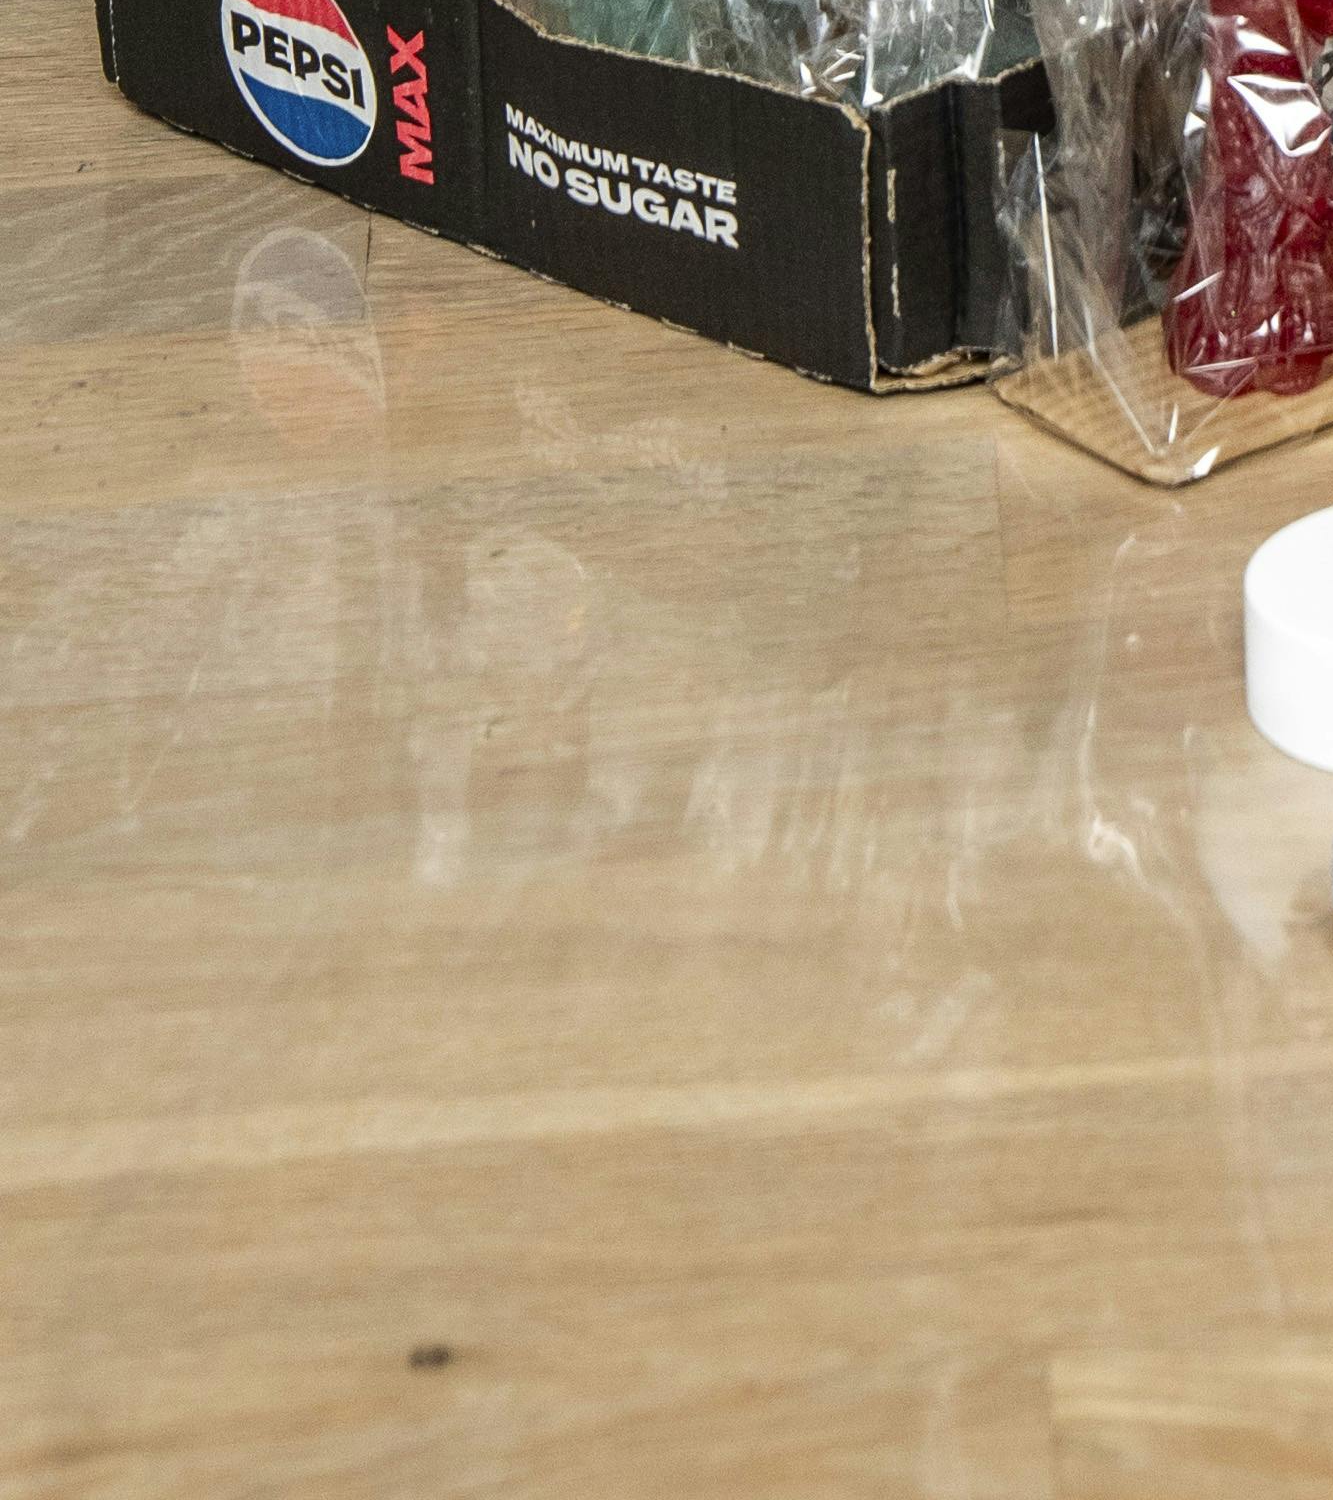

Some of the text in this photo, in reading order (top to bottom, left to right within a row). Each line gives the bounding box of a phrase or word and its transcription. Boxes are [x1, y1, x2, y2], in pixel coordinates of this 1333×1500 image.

[230, 10, 366, 110] PEPSI
[386, 23, 435, 186] MAX
[505, 102, 738, 206] MAXIMUM TASTE
[507, 131, 740, 250] NO SUGAR
